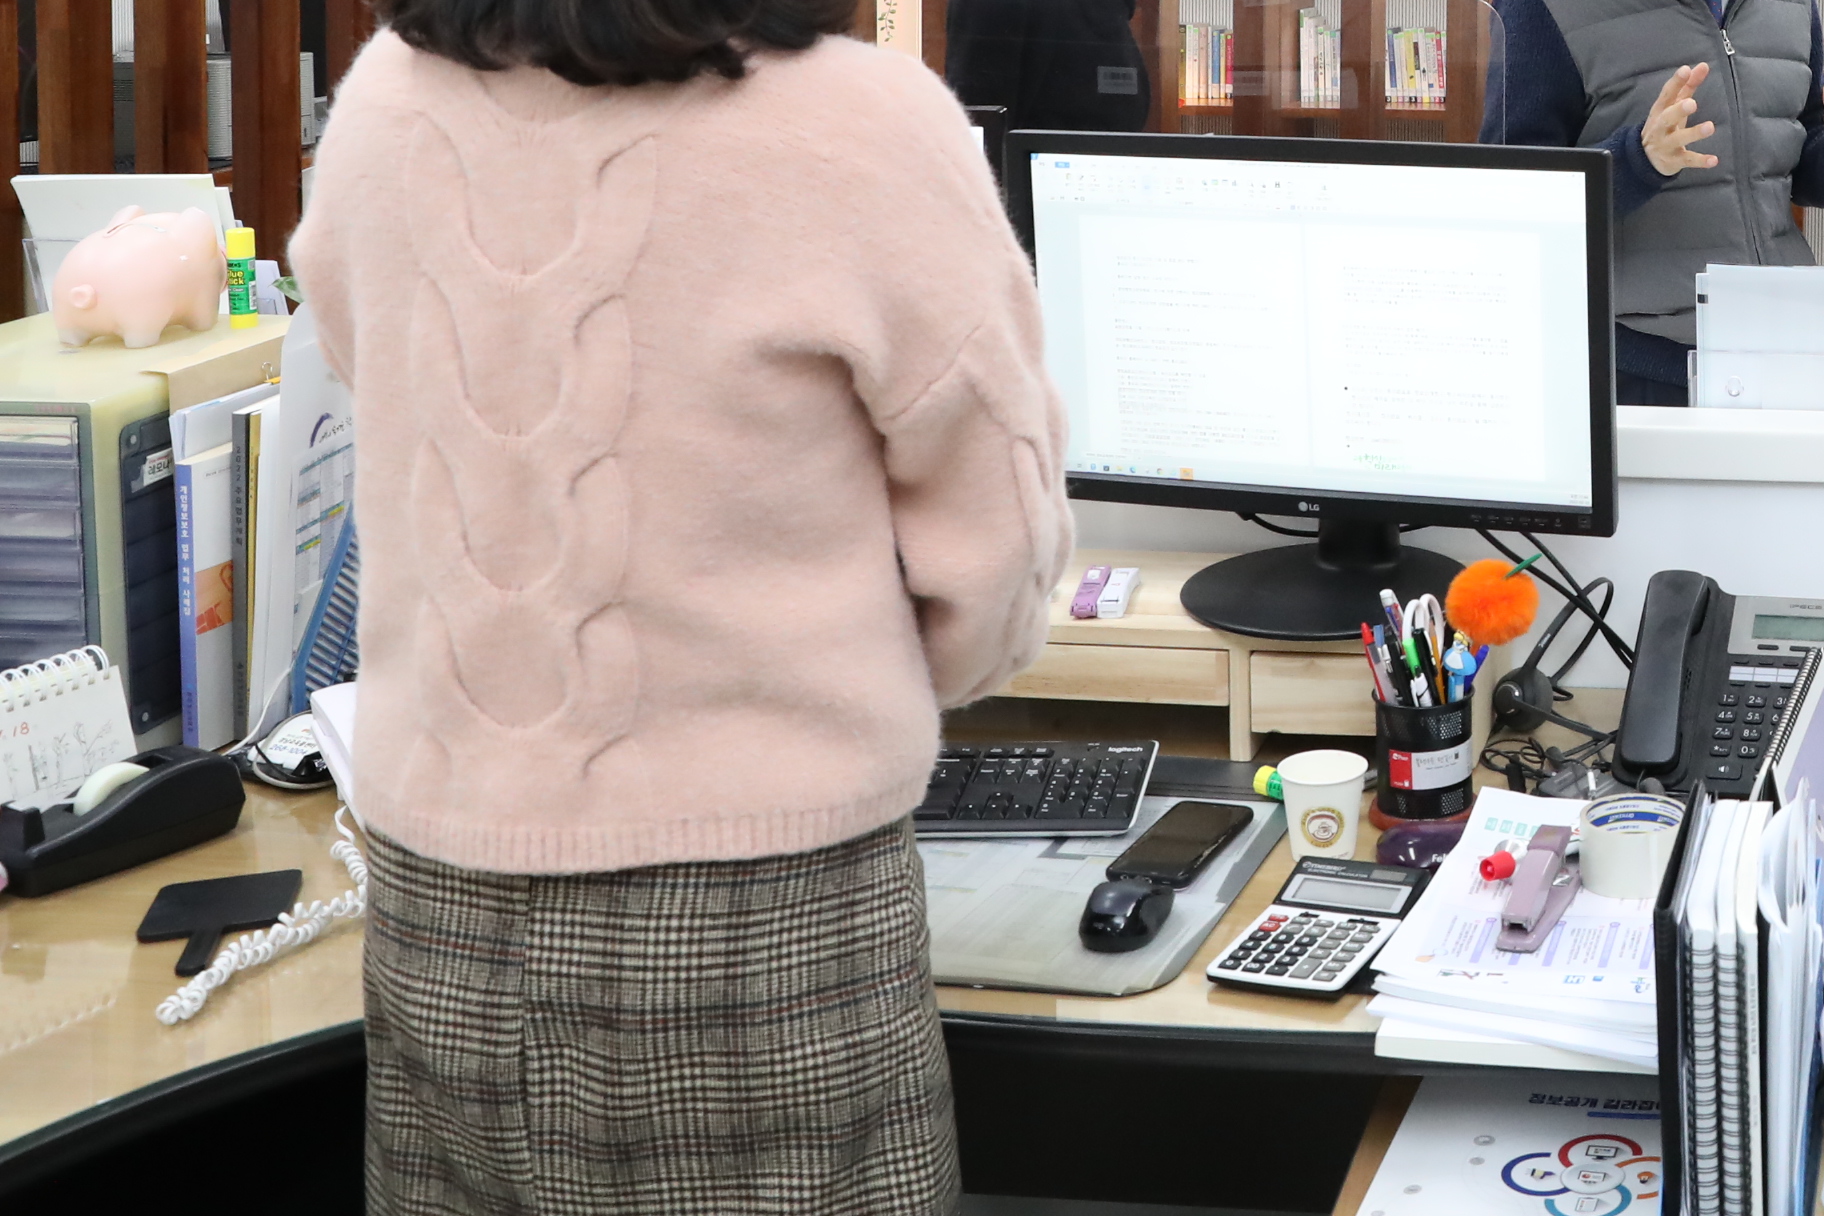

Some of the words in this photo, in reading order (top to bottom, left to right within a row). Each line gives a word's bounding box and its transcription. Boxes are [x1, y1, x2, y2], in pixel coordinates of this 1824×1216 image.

[179, 486, 190, 538] 개인정보보호
[1308, 503, 1320, 511] LG
[1528, 1092, 1599, 1109] 정보공개
[1603, 1098, 1660, 1111] 길라잡
